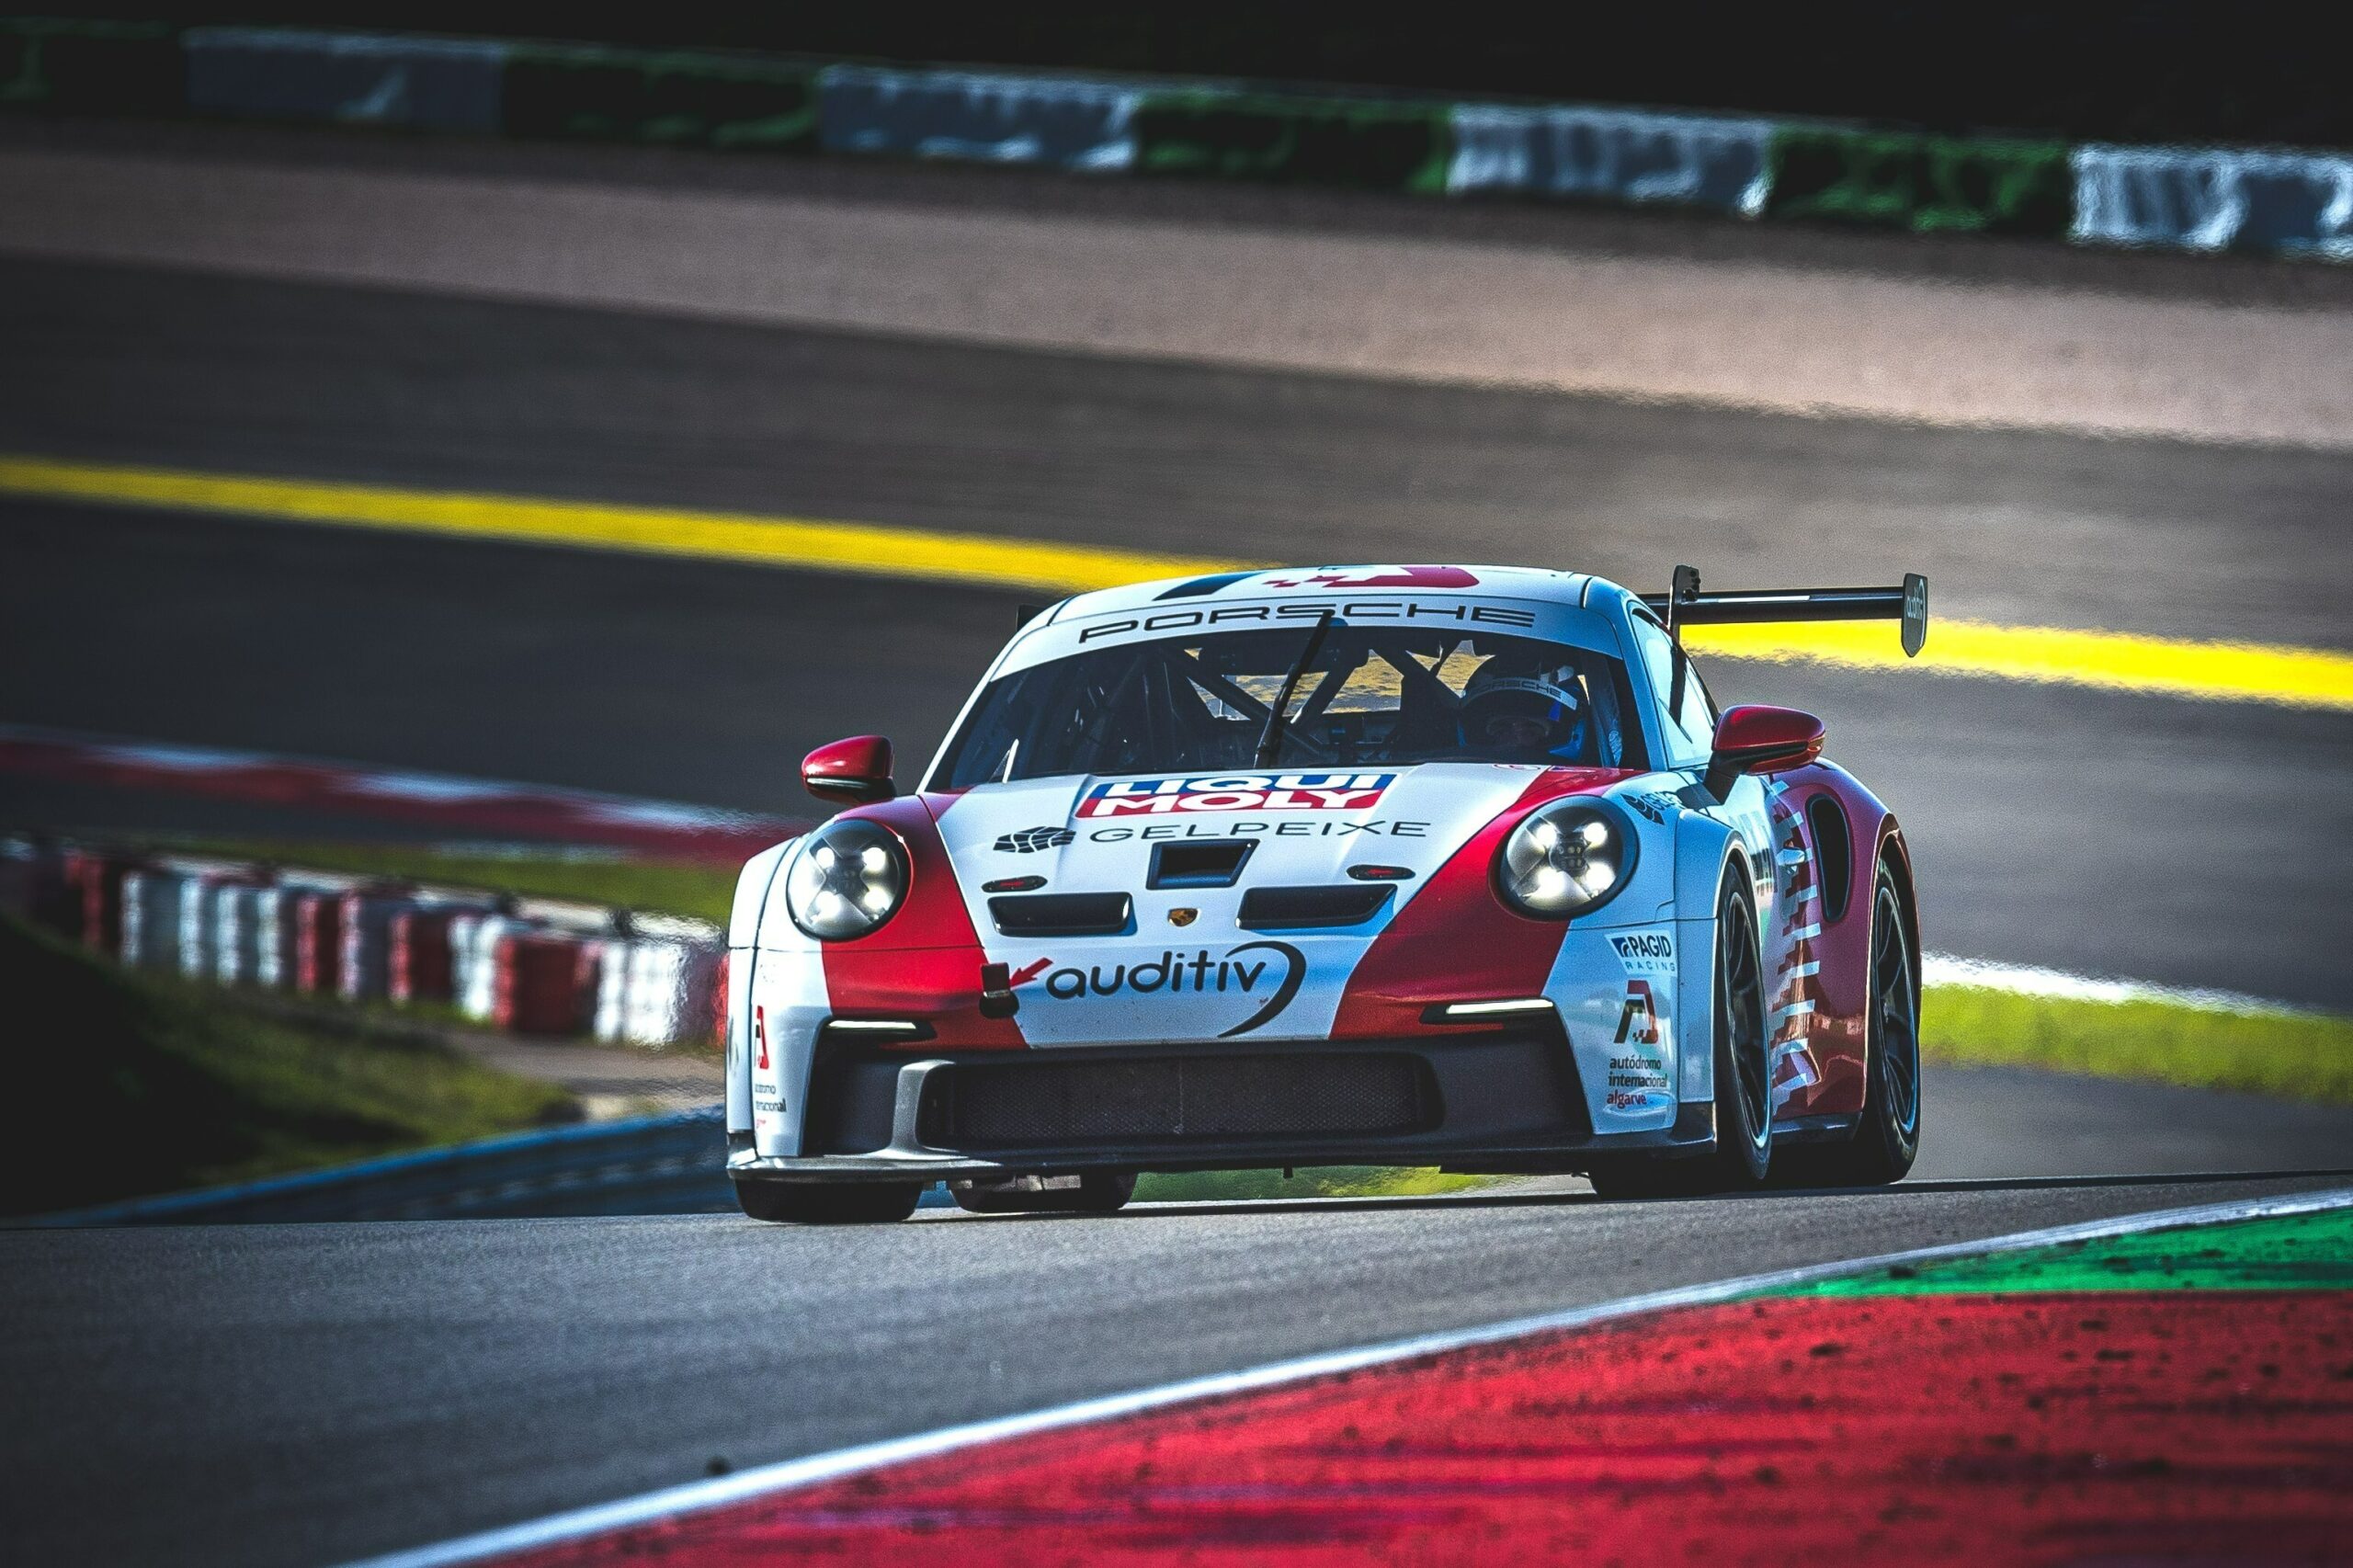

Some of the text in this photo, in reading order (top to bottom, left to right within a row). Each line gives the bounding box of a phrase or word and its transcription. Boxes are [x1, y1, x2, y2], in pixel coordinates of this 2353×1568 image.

[1078, 602, 1537, 644] PORSCHE
[1105, 774, 1381, 798] LIQUI
[1092, 790, 1370, 816] MOLY
[1089, 820, 1432, 844] GELPEIXE
[1627, 935, 1672, 958] PAGID
[1046, 950, 1267, 999] auditiv
[1624, 960, 1677, 972] RACING
[1609, 1053, 1662, 1070] autódromo
[1608, 1071, 1668, 1087] internacional
[1606, 1088, 1648, 1109] algarve
